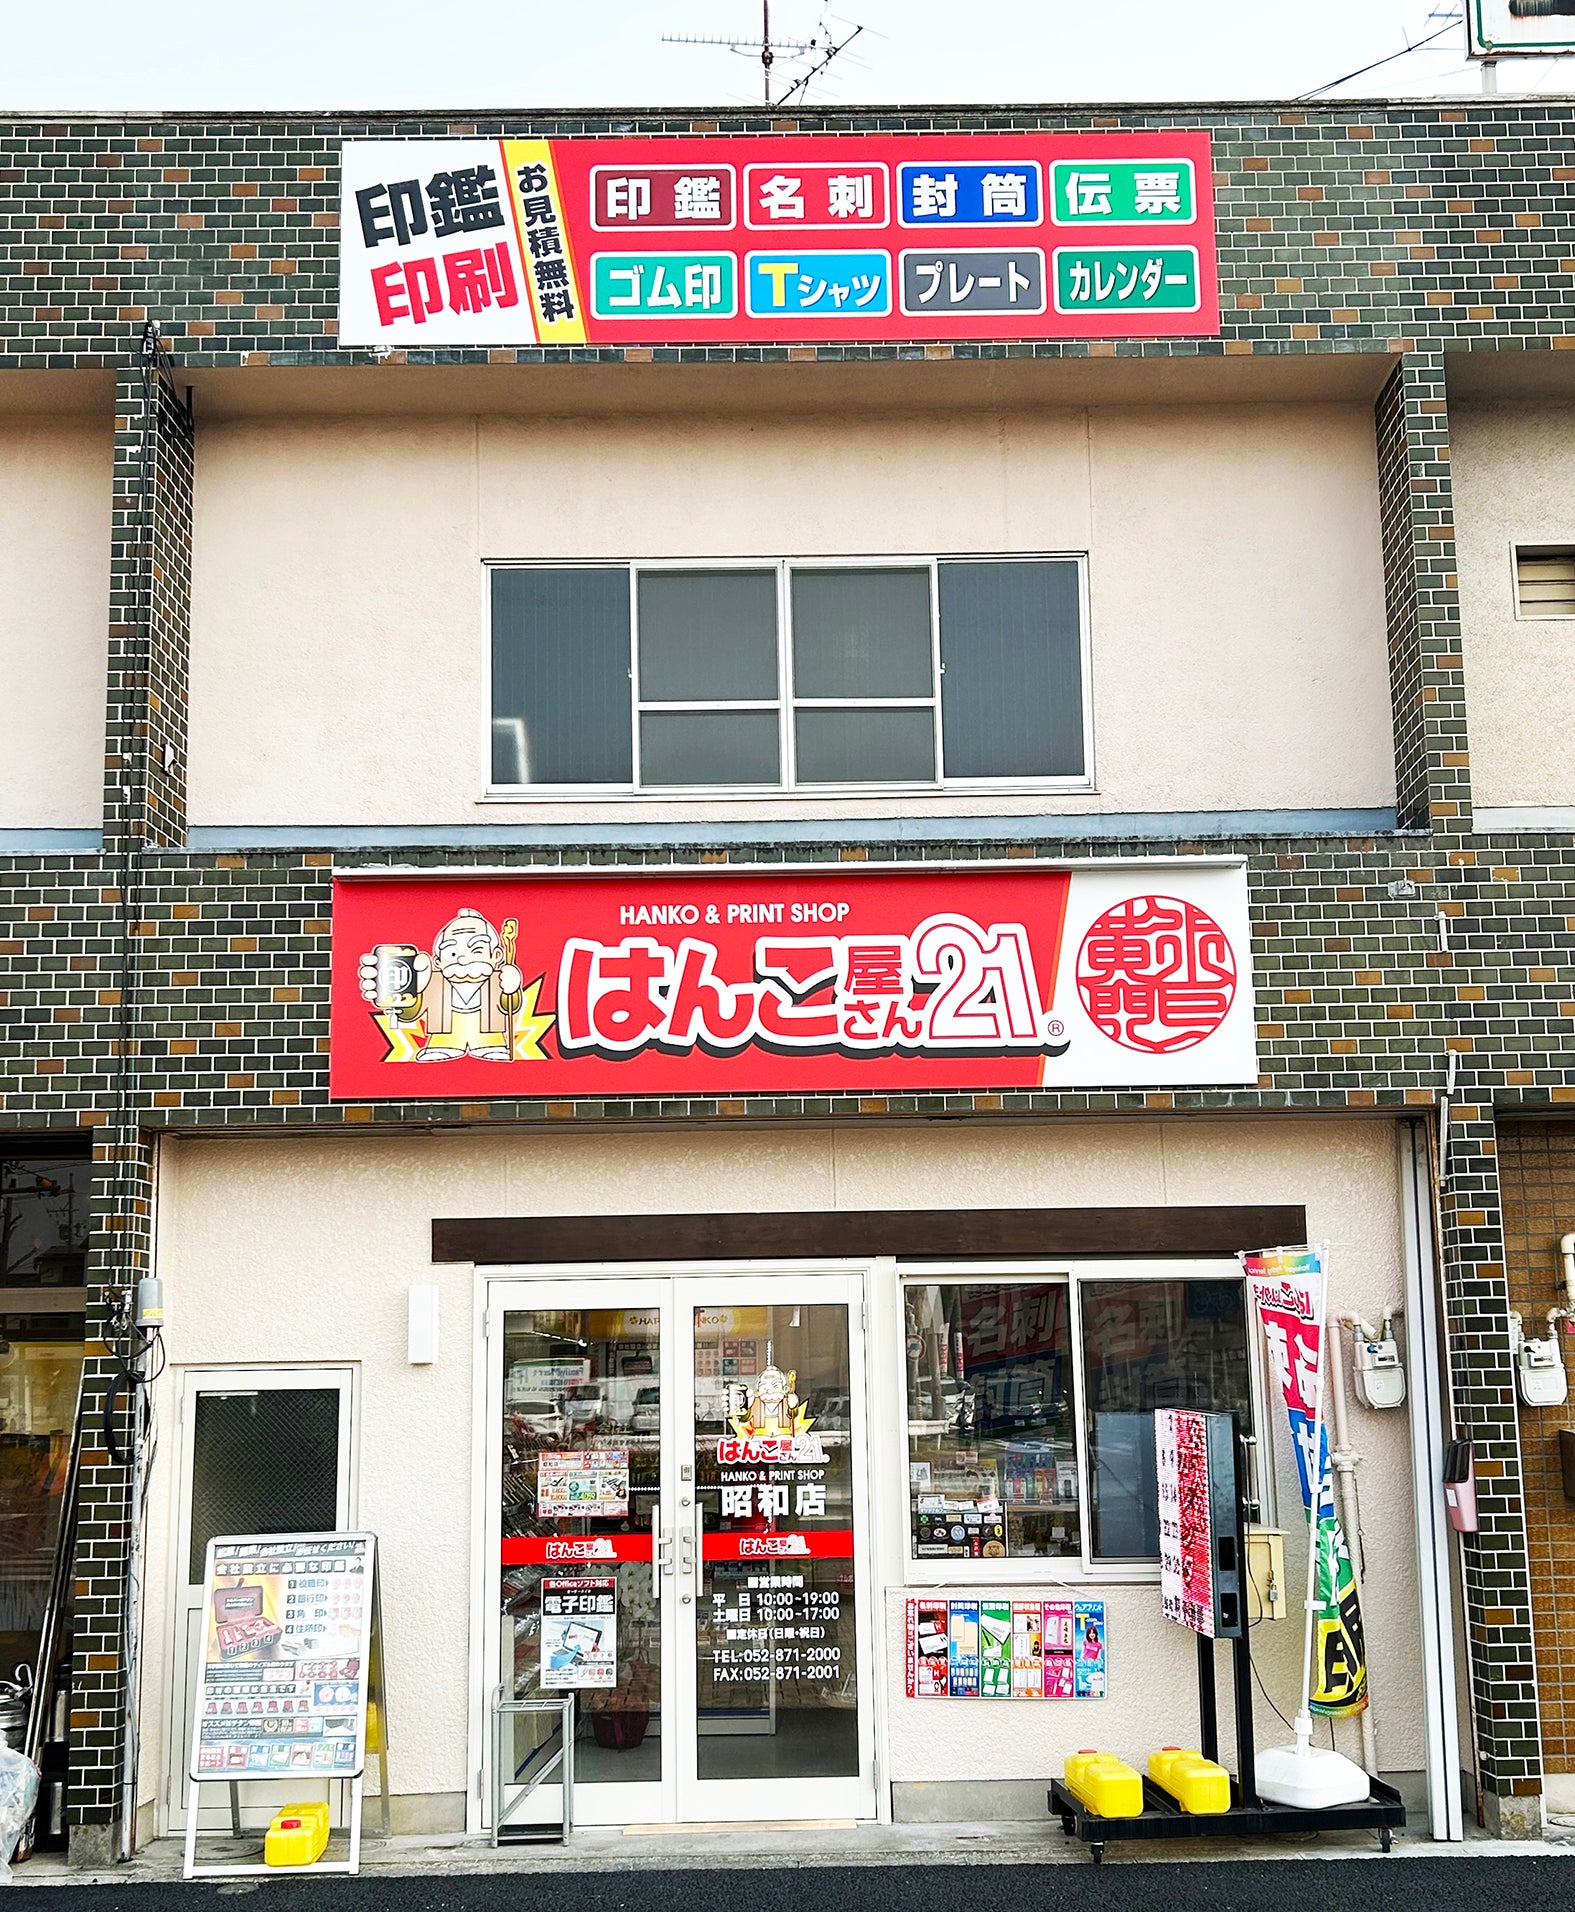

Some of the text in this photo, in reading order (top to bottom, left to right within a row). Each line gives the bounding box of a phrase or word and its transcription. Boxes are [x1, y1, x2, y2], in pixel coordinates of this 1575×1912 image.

[355, 165, 505, 248] 印鑑
[607, 176, 721, 220] 印鑑
[760, 174, 873, 219] 名刺
[912, 173, 1027, 217] 封筒
[1065, 171, 1180, 216] 伝票
[516, 164, 574, 322] お見積無料
[371, 242, 519, 326] 印刷
[608, 263, 721, 310] ゴム印
[758, 263, 881, 308] Tシャツ
[915, 260, 1031, 304] プレート
[1069, 257, 1187, 302] カレンダー
[620, 902, 850, 926] HANKO & PRINT SHOP
[721, 1470, 825, 1482] HANKO & PRINT SHOP
[721, 1483, 826, 1517] 昭和店
[545, 1595, 613, 1613] 電子印鑑
[712, 1607, 751, 1622] 土曜日
[712, 1647, 841, 1663] TEL:052-871-2000
[713, 1665, 840, 1681] FAX:052-871-2001
